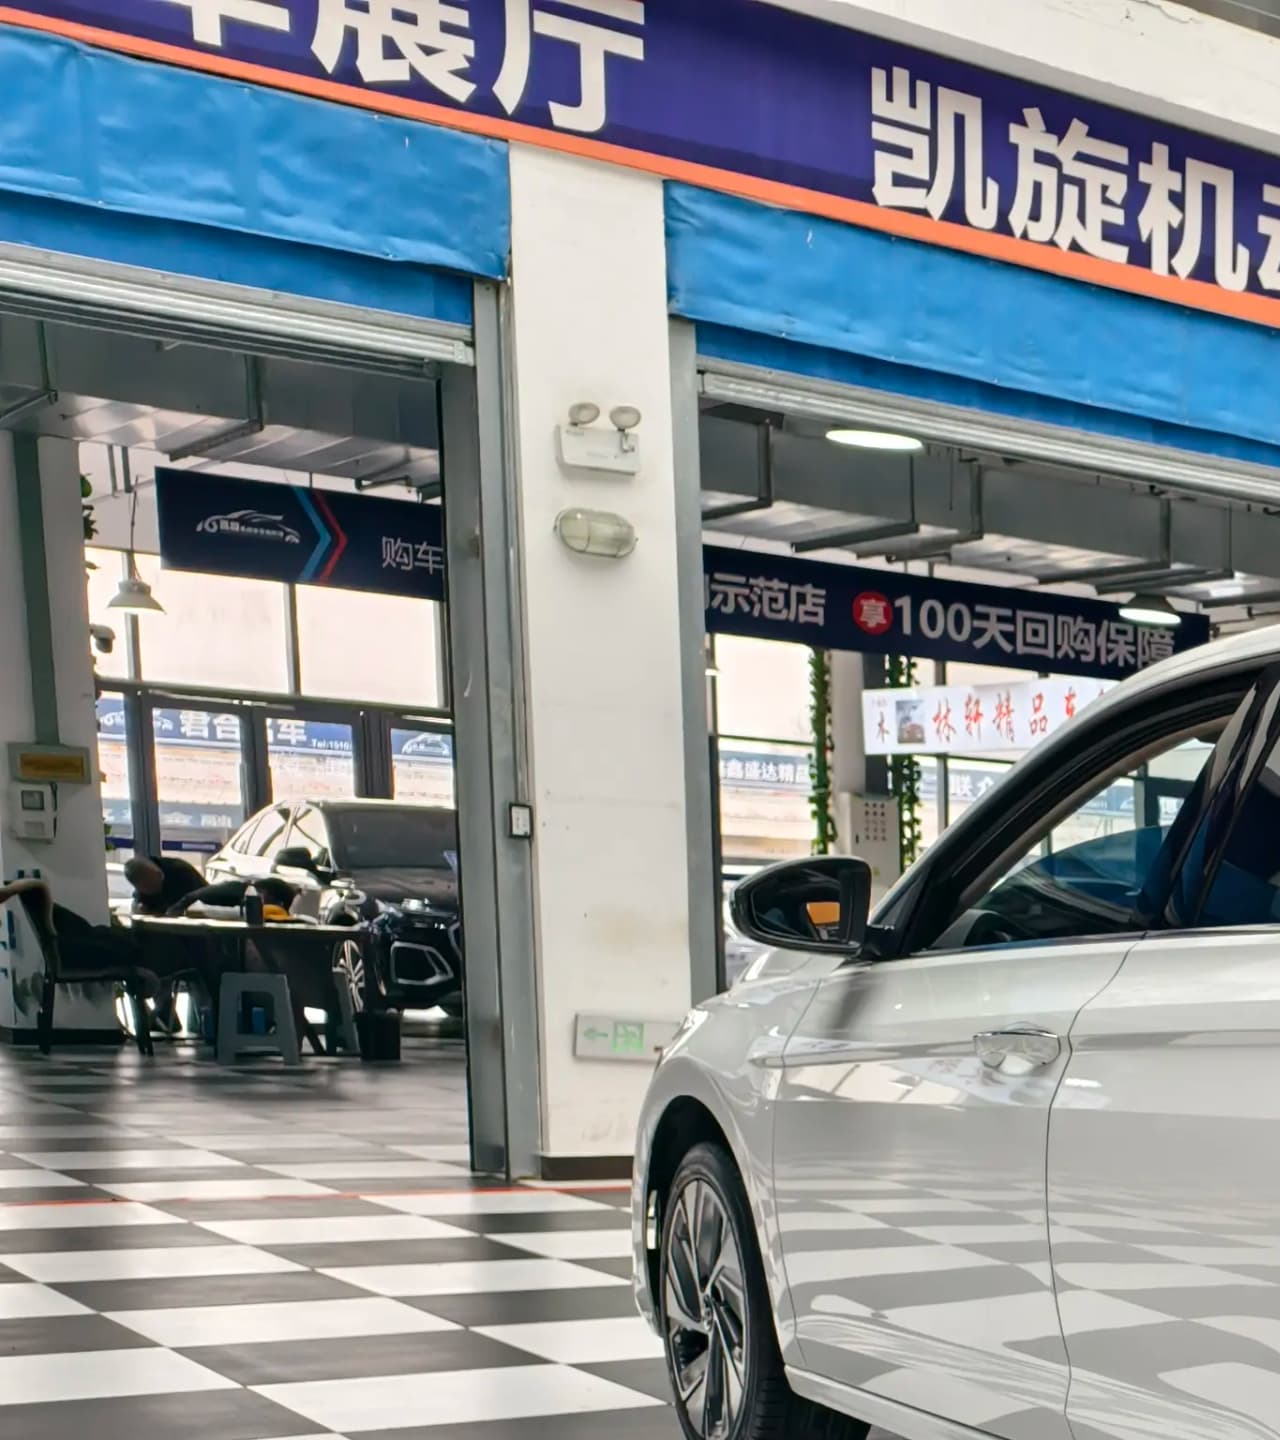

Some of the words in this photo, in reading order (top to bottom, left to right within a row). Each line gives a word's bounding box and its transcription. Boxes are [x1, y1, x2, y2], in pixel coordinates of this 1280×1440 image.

[381, 535, 444, 576] 购车
[704, 571, 827, 628] 示范店
